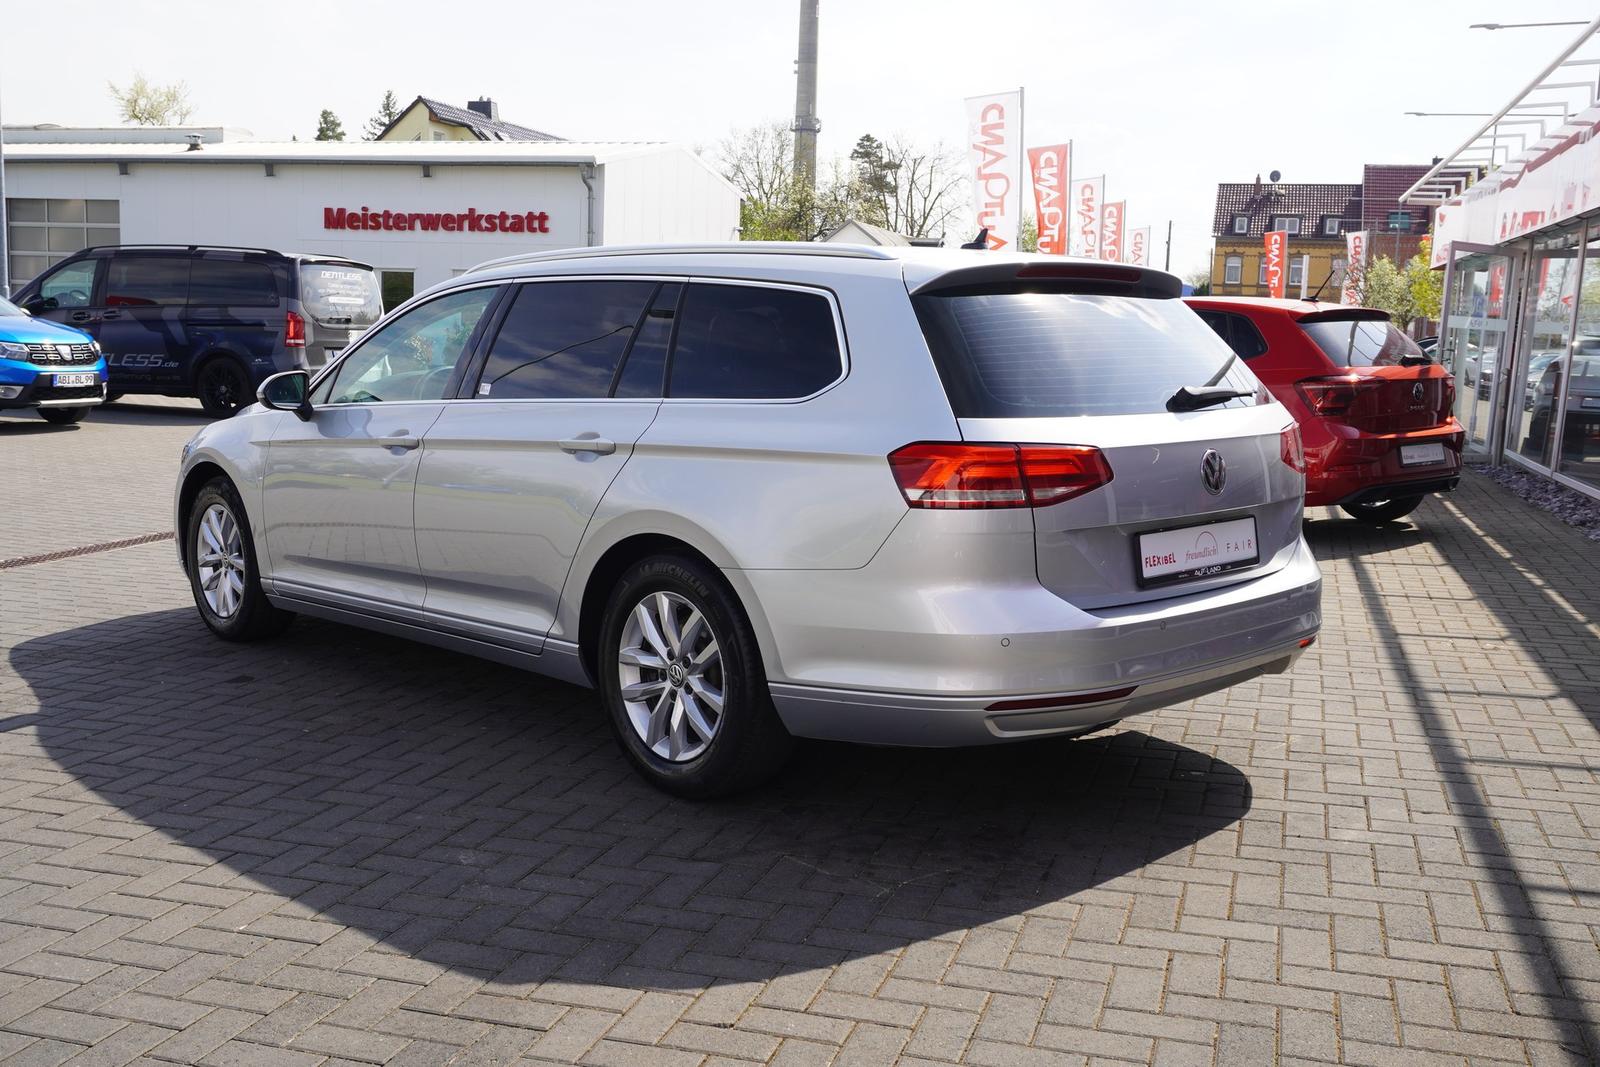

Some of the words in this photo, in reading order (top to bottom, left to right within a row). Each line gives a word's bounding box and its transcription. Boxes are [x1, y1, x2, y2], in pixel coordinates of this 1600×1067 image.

[324, 206, 549, 233] Meisterwerkstatt
[1144, 552, 1177, 568] FLEXIBEL
[1185, 545, 1217, 563] freundlich
[1226, 538, 1253, 553] FAIR
[654, 562, 710, 598] MICHELIN
